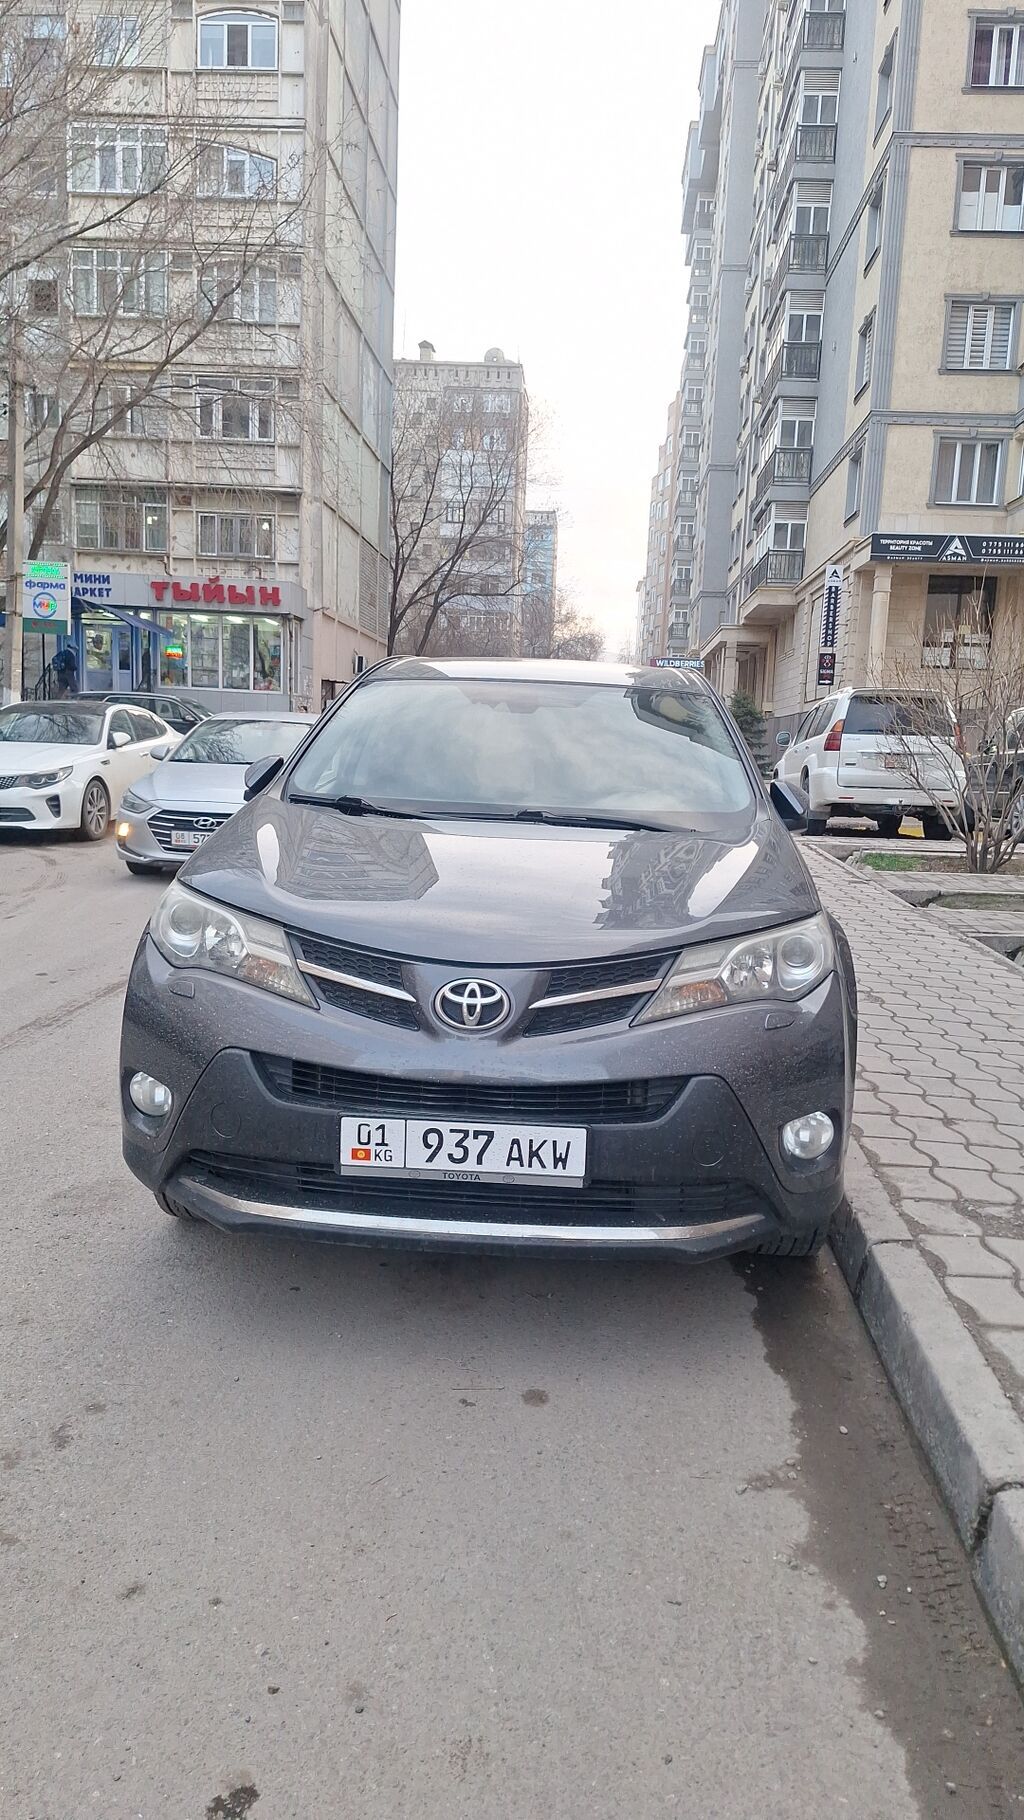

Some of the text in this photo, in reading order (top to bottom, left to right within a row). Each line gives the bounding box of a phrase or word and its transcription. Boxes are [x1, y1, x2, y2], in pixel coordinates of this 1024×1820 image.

[25, 579, 66, 590] фарма
[73, 573, 111, 585] МИНИ
[71, 586, 112, 598] АРКЕТ
[150, 575, 282, 607] ТЫЙЫН
[655, 659, 705, 668] WILDBERRIES
[193, 834, 211, 844] 57
[357, 1123, 571, 1171] 01 937 AKW
[374, 1149, 393, 1162] KG
[442, 1172, 481, 1181] TOYOTA
